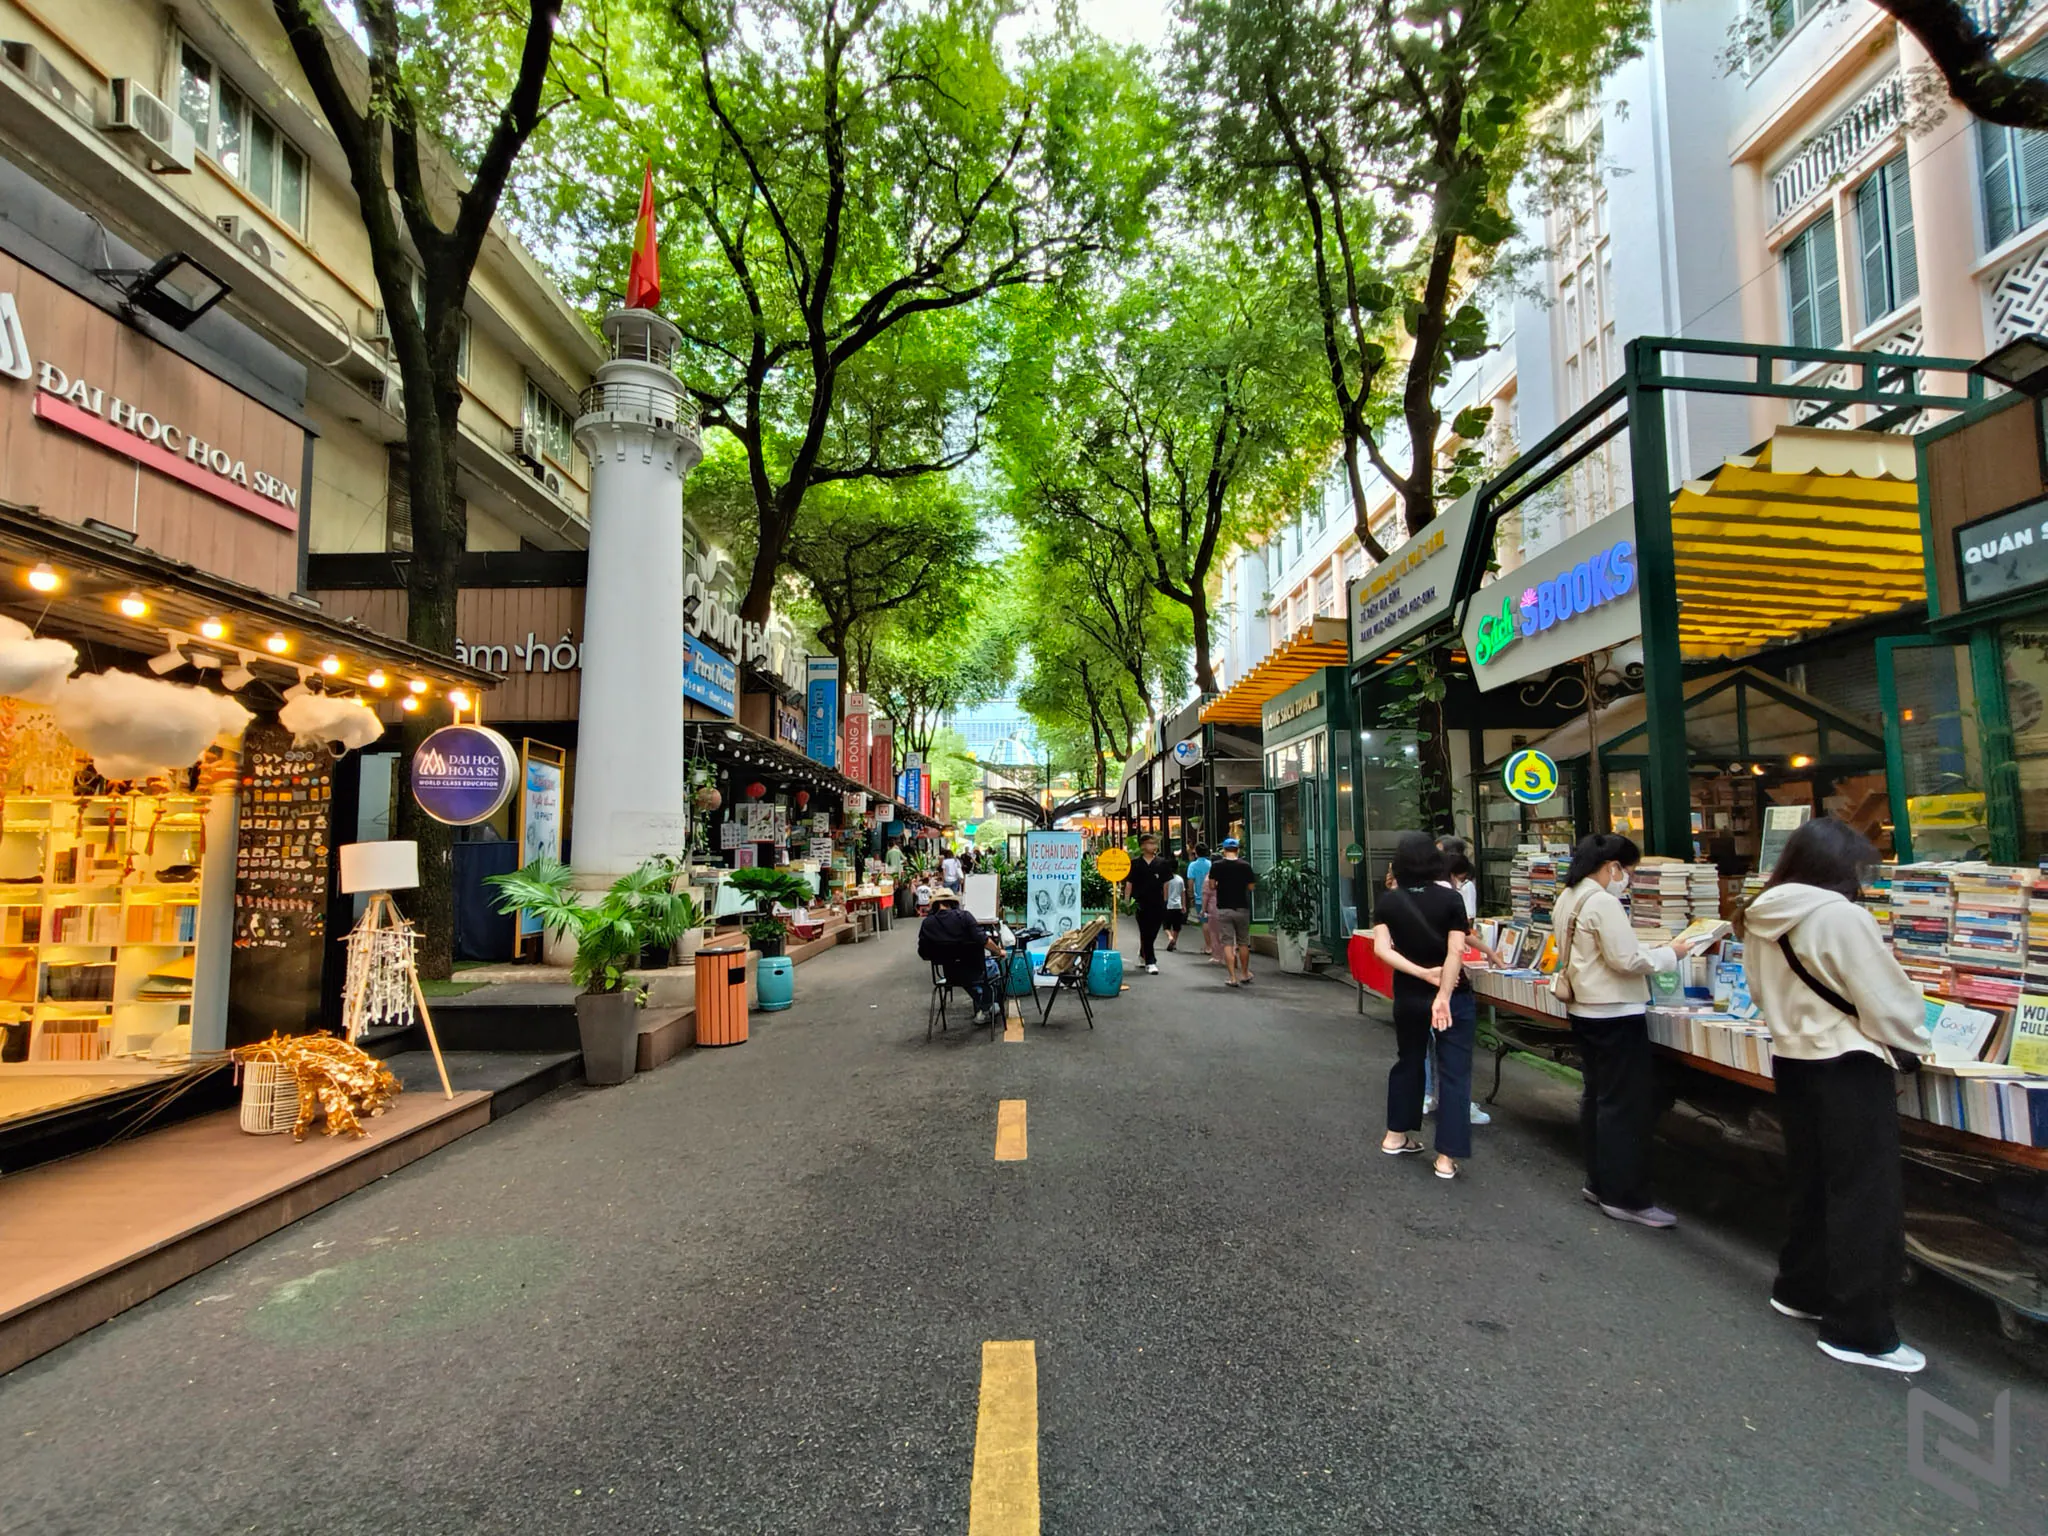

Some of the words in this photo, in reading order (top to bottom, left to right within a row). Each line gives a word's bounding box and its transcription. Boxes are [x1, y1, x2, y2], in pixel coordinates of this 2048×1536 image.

[186, 434, 250, 487] HOA
[253, 471, 298, 508] SEN
[1964, 527, 2034, 564] QUÁN
[456, 638, 508, 672] âm
[515, 628, 583, 672] hồ
[449, 767, 475, 777] HOA
[476, 767, 500, 777] SEN
[462, 780, 499, 788] EDUCATION
[1940, 1017, 1977, 1035] Google
